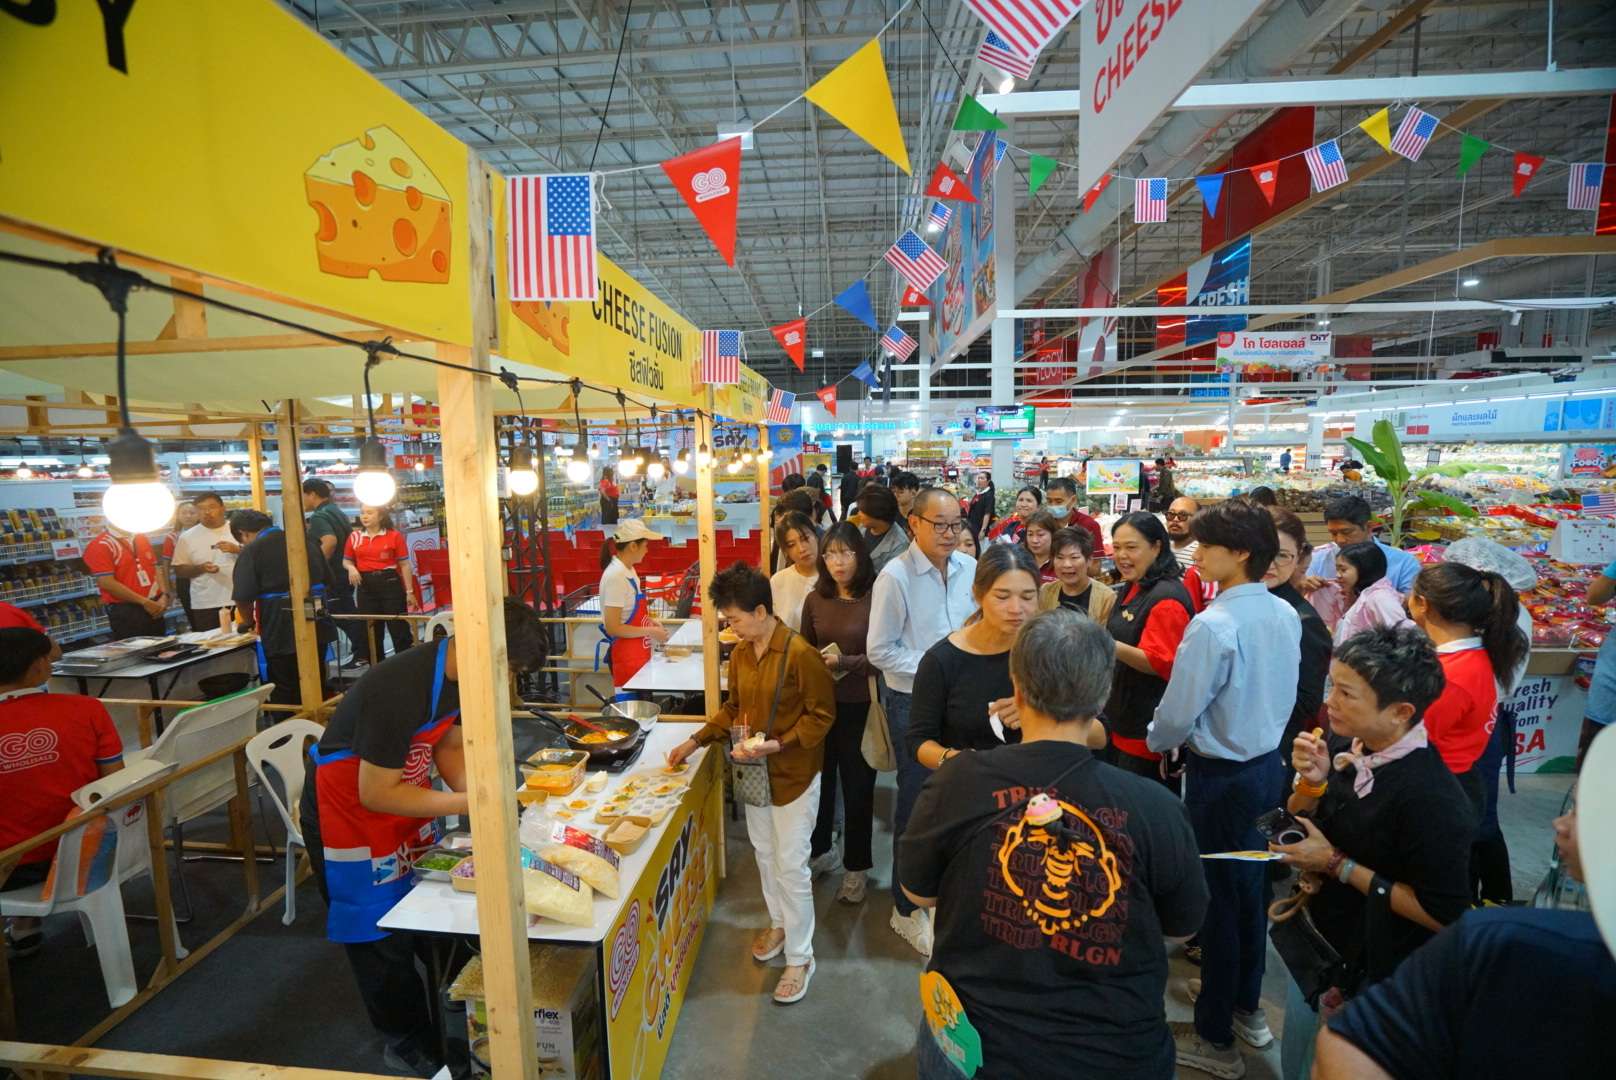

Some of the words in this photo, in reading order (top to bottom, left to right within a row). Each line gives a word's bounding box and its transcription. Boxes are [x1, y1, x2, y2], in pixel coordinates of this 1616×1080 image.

[592, 277, 646, 343] CHEESE
[648, 312, 682, 361] FUSION
[1512, 677, 1552, 698] resh
[1504, 694, 1559, 714] uality
[1514, 728, 1546, 756] SA
[656, 814, 693, 931] SAY
[1050, 934, 1121, 966] RLGN
[534, 1008, 559, 1020] rflex
